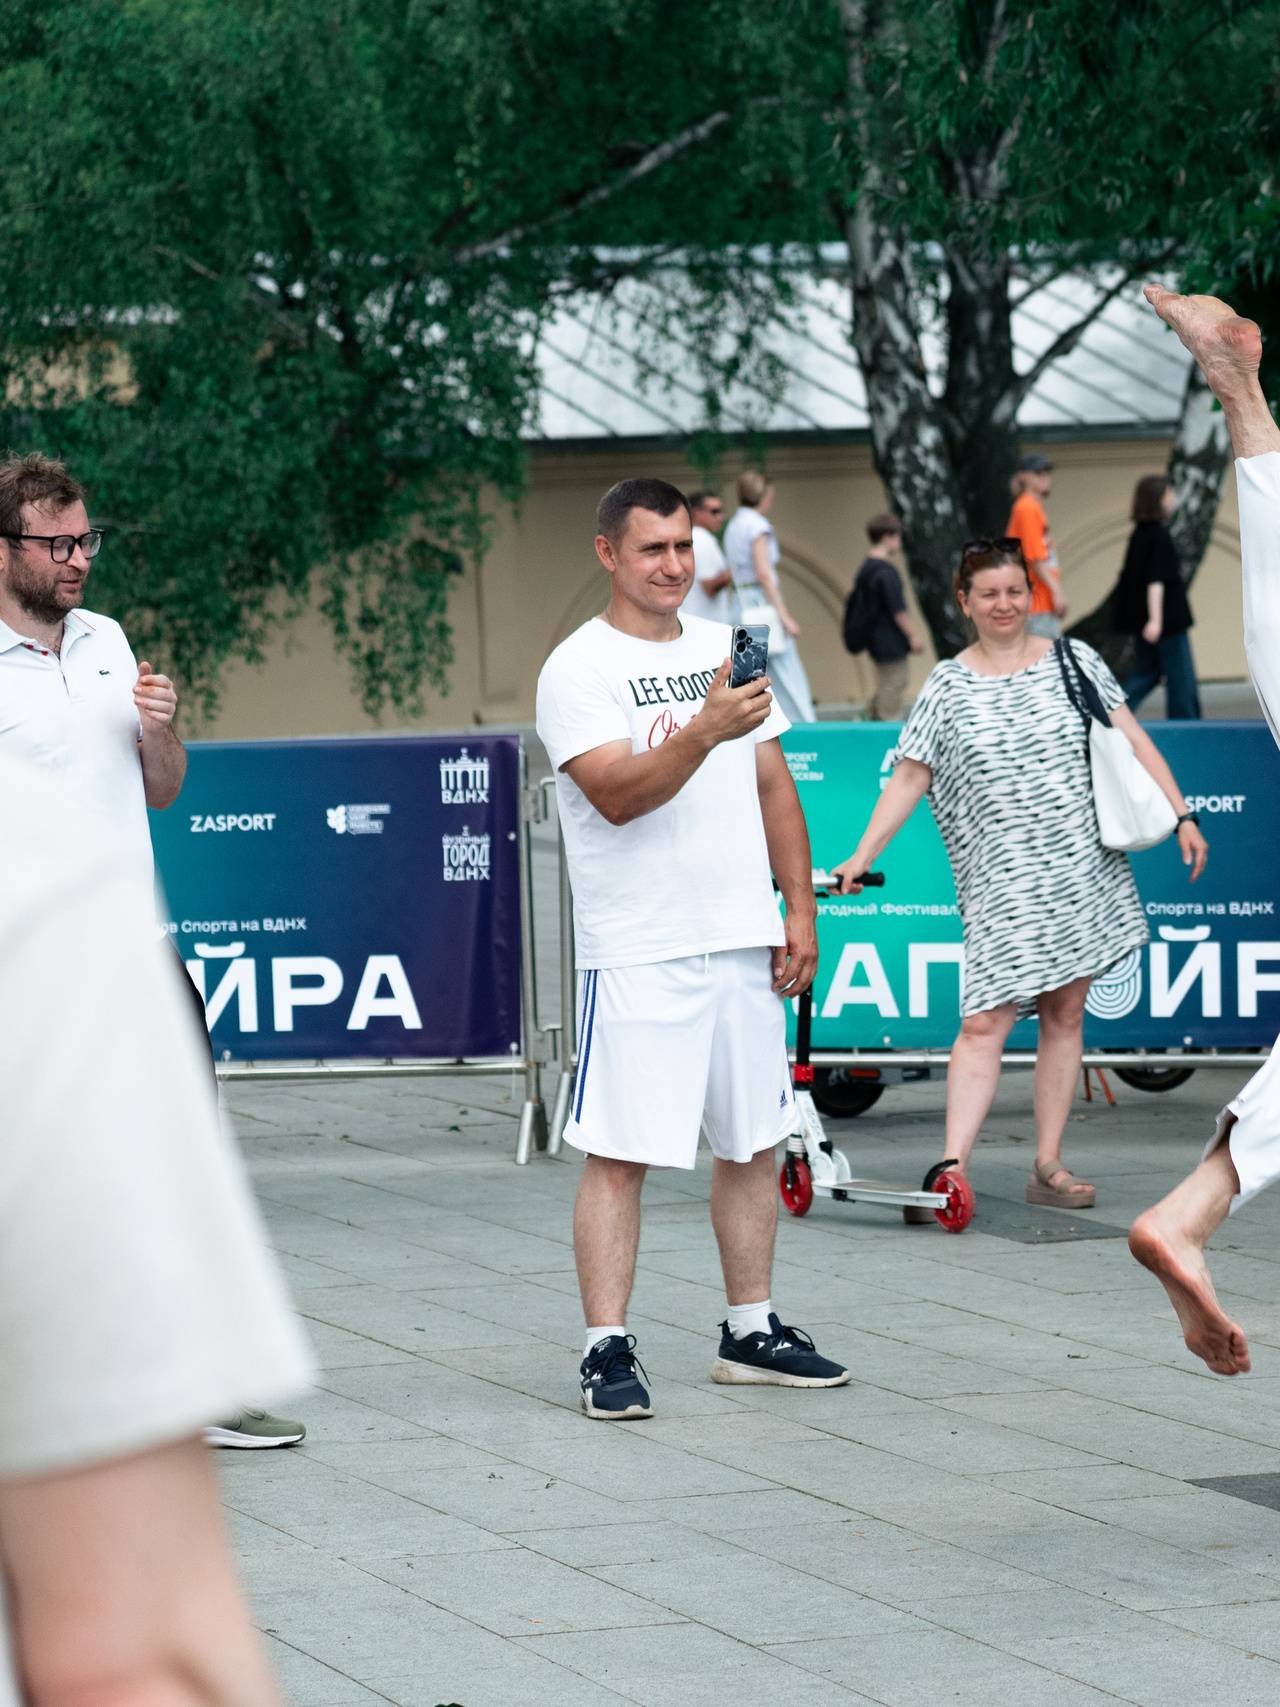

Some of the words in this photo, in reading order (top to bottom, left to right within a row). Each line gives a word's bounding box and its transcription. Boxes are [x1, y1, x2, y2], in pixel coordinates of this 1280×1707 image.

[628, 677, 669, 707] LEE
[441, 789, 489, 804] ВДНХ
[1186, 795, 1246, 812] SPORT
[190, 813, 276, 832] ZASPORT
[442, 844, 491, 867] ГОРОД
[443, 866, 491, 881] ВДНХ
[881, 903, 959, 916] Фестивал
[1146, 902, 1203, 916] Спорта
[1207, 903, 1226, 914] на
[1229, 902, 1274, 916] ВДНХ
[181, 919, 238, 934] Спорта
[241, 920, 260, 932] на
[263, 917, 307, 932] ВДНХ
